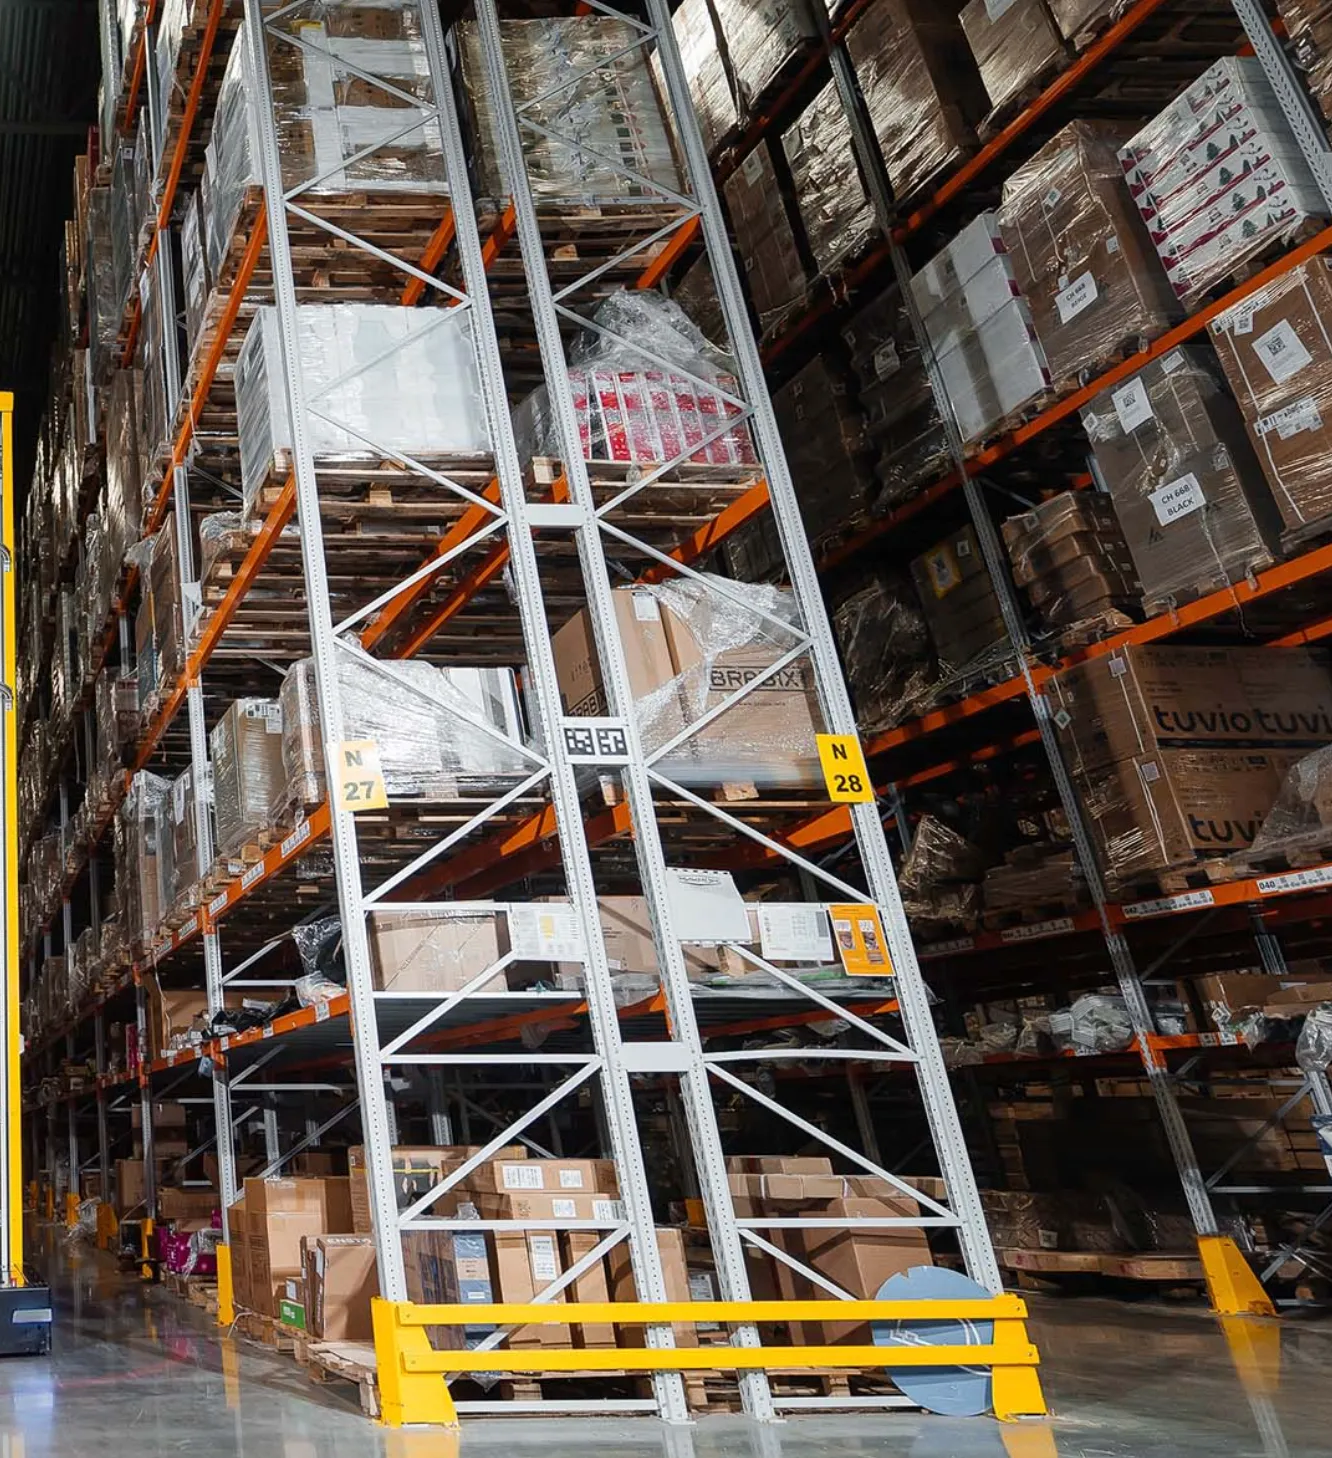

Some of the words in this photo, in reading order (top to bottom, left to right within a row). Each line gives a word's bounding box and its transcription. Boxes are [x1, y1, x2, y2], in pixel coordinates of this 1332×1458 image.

[1161, 494, 1174, 504] CH
[1167, 496, 1195, 516] BLACK
[1152, 704, 1252, 733] tuvio
[1254, 706, 1332, 734] tuvi
[344, 750, 363, 767] N
[831, 743, 848, 760] N
[343, 781, 375, 801] 27
[833, 774, 863, 792] 28
